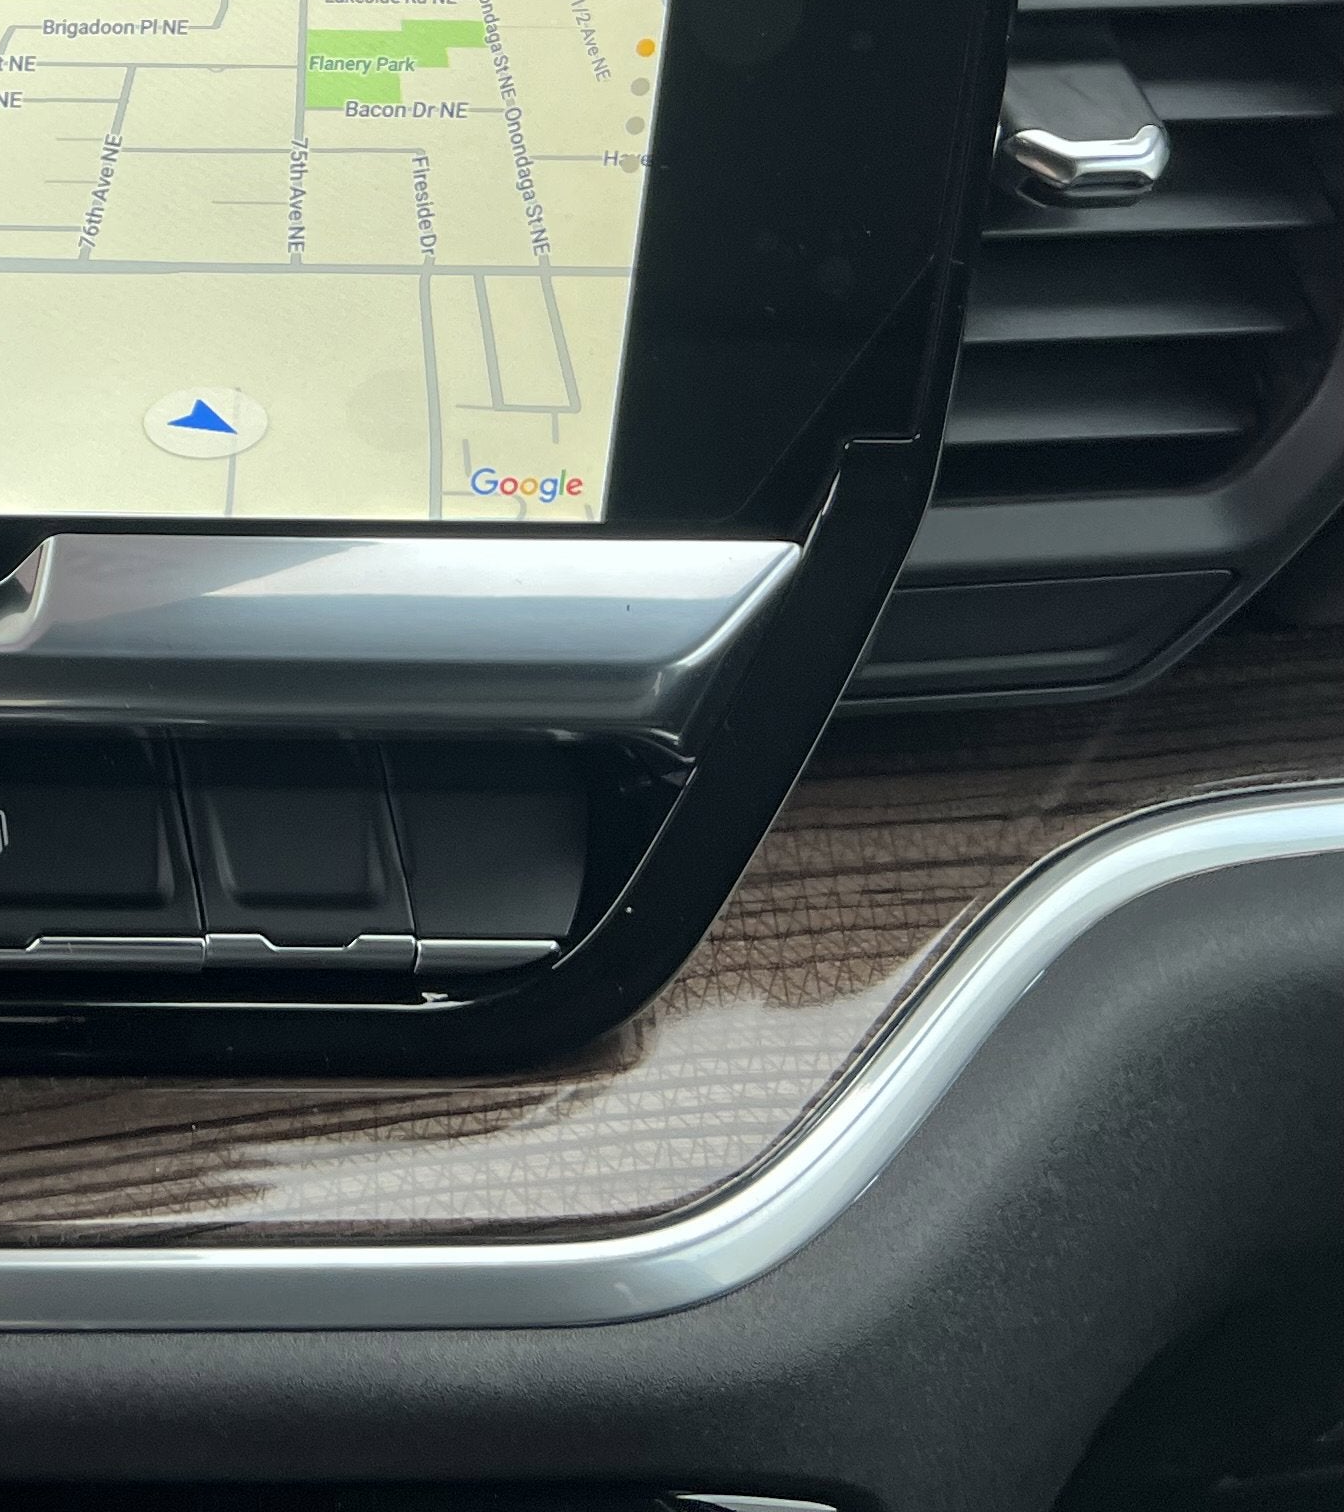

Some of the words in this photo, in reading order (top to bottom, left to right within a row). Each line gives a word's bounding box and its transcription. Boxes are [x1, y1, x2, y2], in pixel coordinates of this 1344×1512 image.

[42, 19, 135, 37] Brigadoon
[139, 19, 157, 35] Pl
[162, 20, 189, 35] NE
[9, 56, 36, 71] NE
[309, 56, 371, 75] Flanery
[376, 56, 415, 72] Park
[493, 54, 509, 74] St
[580, 28, 600, 57] Ave
[591, 56, 612, 82] NE
[498, 75, 517, 101] NE
[345, 101, 407, 118] Bacon
[412, 102, 435, 118] Dr
[440, 102, 468, 118] NE
[100, 134, 123, 163] NE
[289, 138, 309, 181] 75th
[504, 107, 536, 202] Onondaga
[91, 165, 114, 203] Ave
[412, 155, 436, 231] Fireside
[288, 186, 307, 221] Ave
[525, 204, 544, 227] St
[78, 204, 105, 248] 76th
[288, 226, 306, 253] NE
[419, 234, 438, 256] Dr
[530, 227, 551, 256] NE
[470, 467, 583, 504] Google
